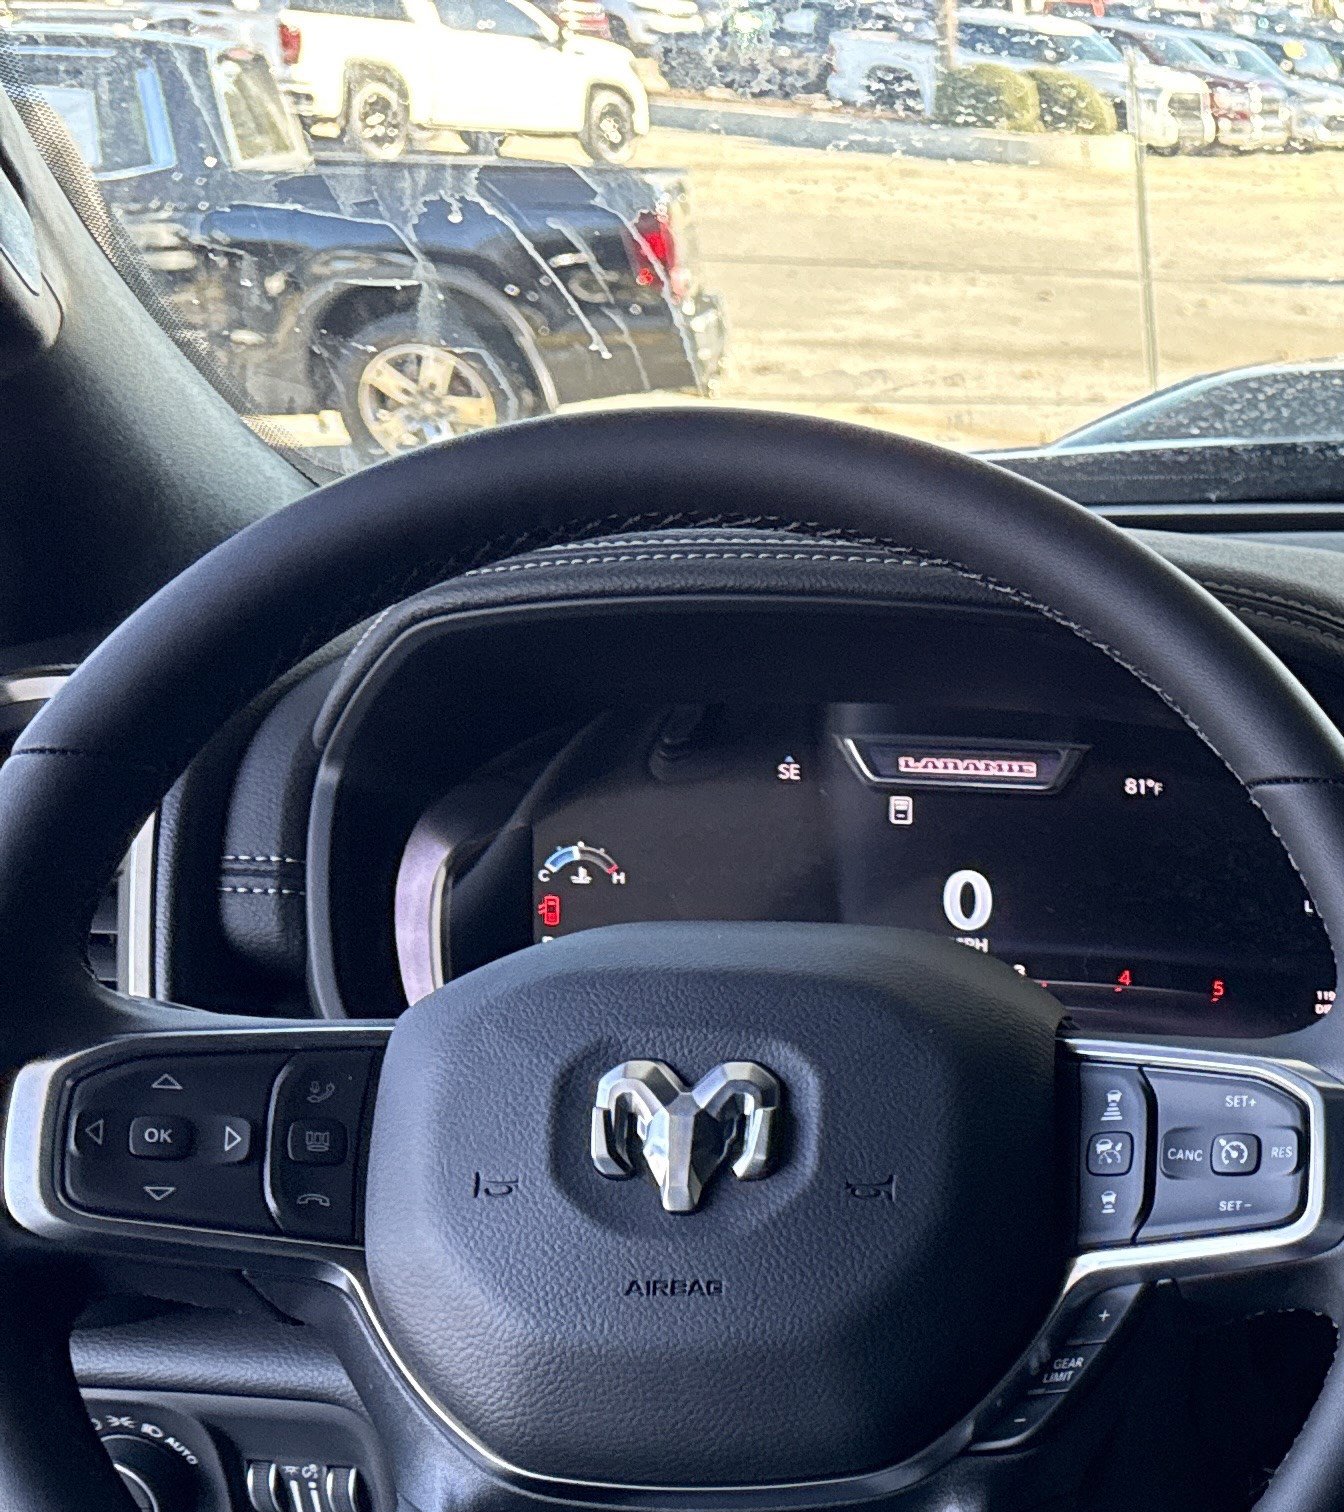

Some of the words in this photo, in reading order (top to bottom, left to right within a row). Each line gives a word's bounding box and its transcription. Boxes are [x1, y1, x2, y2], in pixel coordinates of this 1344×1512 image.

[777, 764, 801, 781] SE
[899, 756, 1037, 779] LARAMIE
[538, 869, 550, 882] C
[612, 872, 626, 884] H
[942, 869, 993, 932] 0
[1118, 969, 1132, 987] 4
[1212, 980, 1224, 996] 5
[144, 1127, 173, 1144] OK
[1167, 1148, 1203, 1162] CANC
[1270, 1147, 1293, 1159] RES
[624, 1279, 724, 1297] AIRBAG
[1053, 1356, 1085, 1369] GEAR
[164, 1437, 198, 1465] AUTO
